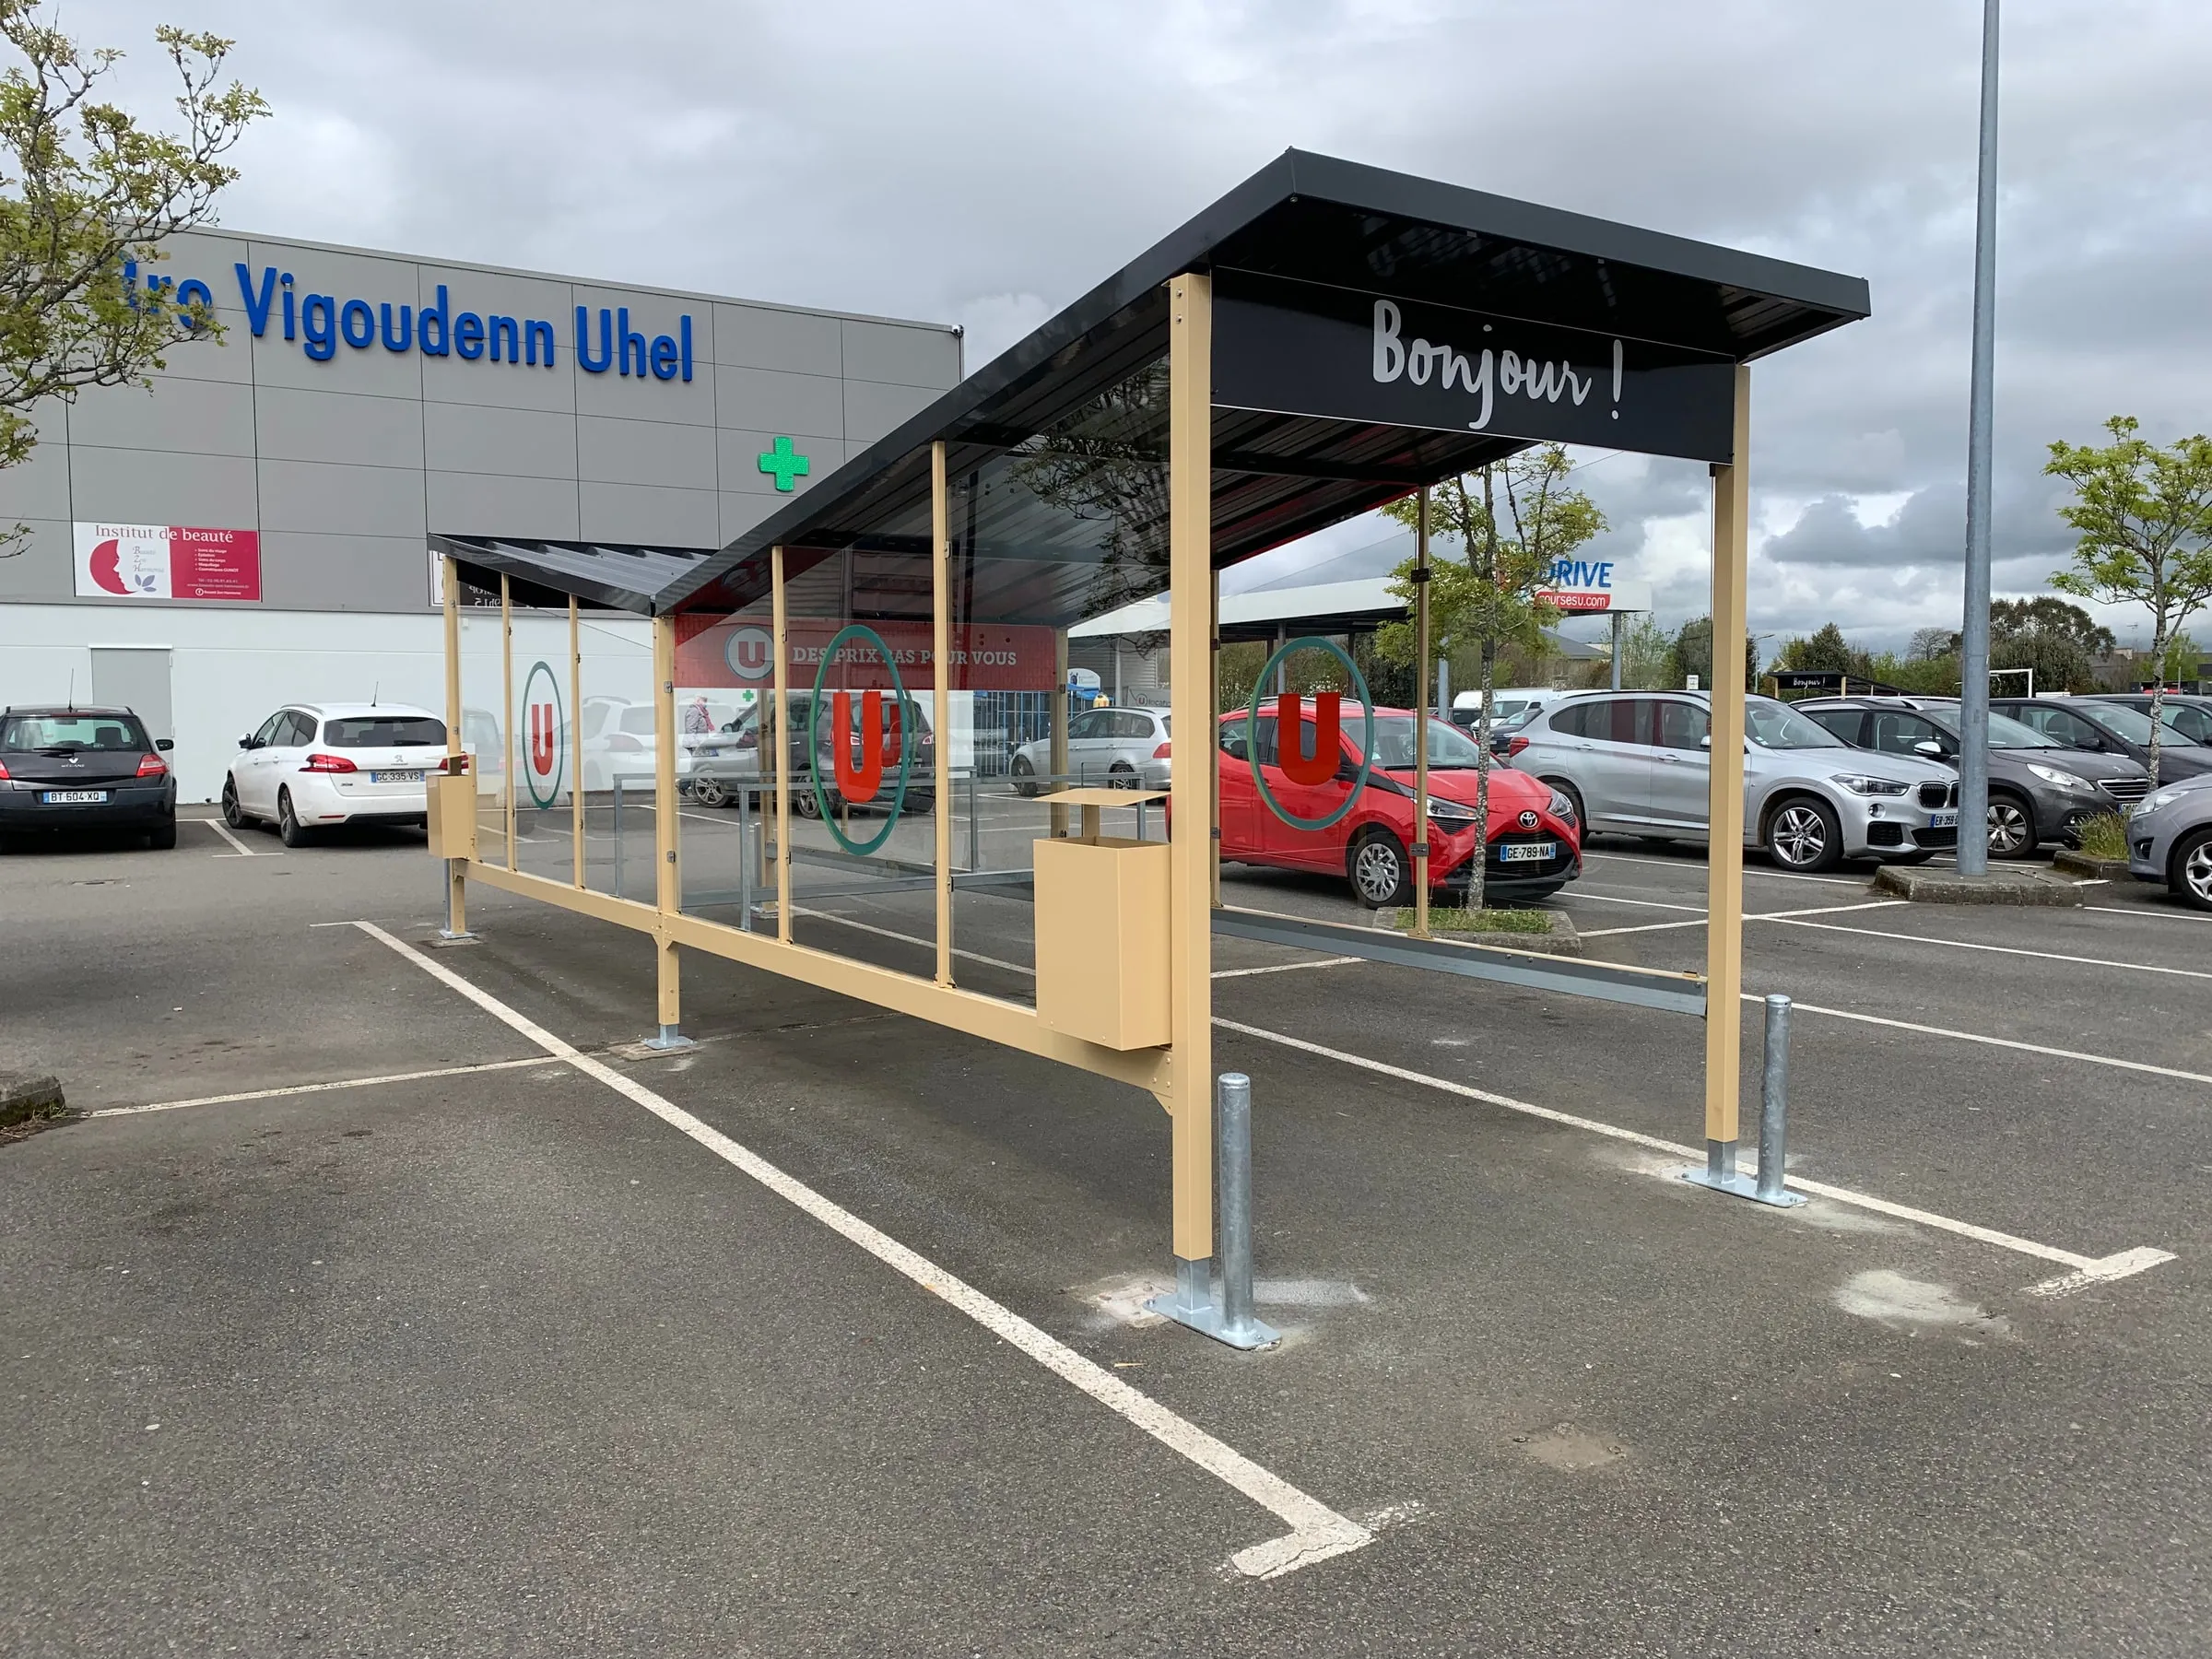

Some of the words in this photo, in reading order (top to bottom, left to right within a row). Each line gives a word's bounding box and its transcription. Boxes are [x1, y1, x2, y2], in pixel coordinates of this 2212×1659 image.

[234, 262, 555, 367] Vigoudenn
[575, 305, 693, 382] Uhel
[1373, 300, 1592, 429] Bonjour
[1612, 339, 1623, 420] !
[95, 524, 153, 539] Institut
[159, 527, 178, 540] de
[182, 528, 234, 544] beauté
[738, 641, 766, 669] U
[793, 647, 828, 662] DES
[834, 648, 878, 664] PRIX
[920, 650, 968, 665] PUR
[971, 651, 1017, 665] VOUS
[1793, 677, 1821, 689] Bonjour
[532, 703, 553, 775] U
[832, 691, 882, 803] U
[1278, 692, 1340, 785] U
[376, 771, 419, 782] GC-335-VS
[51, 793, 100, 802] BT-604-XQ
[1507, 846, 1549, 859] GE-789-NA
